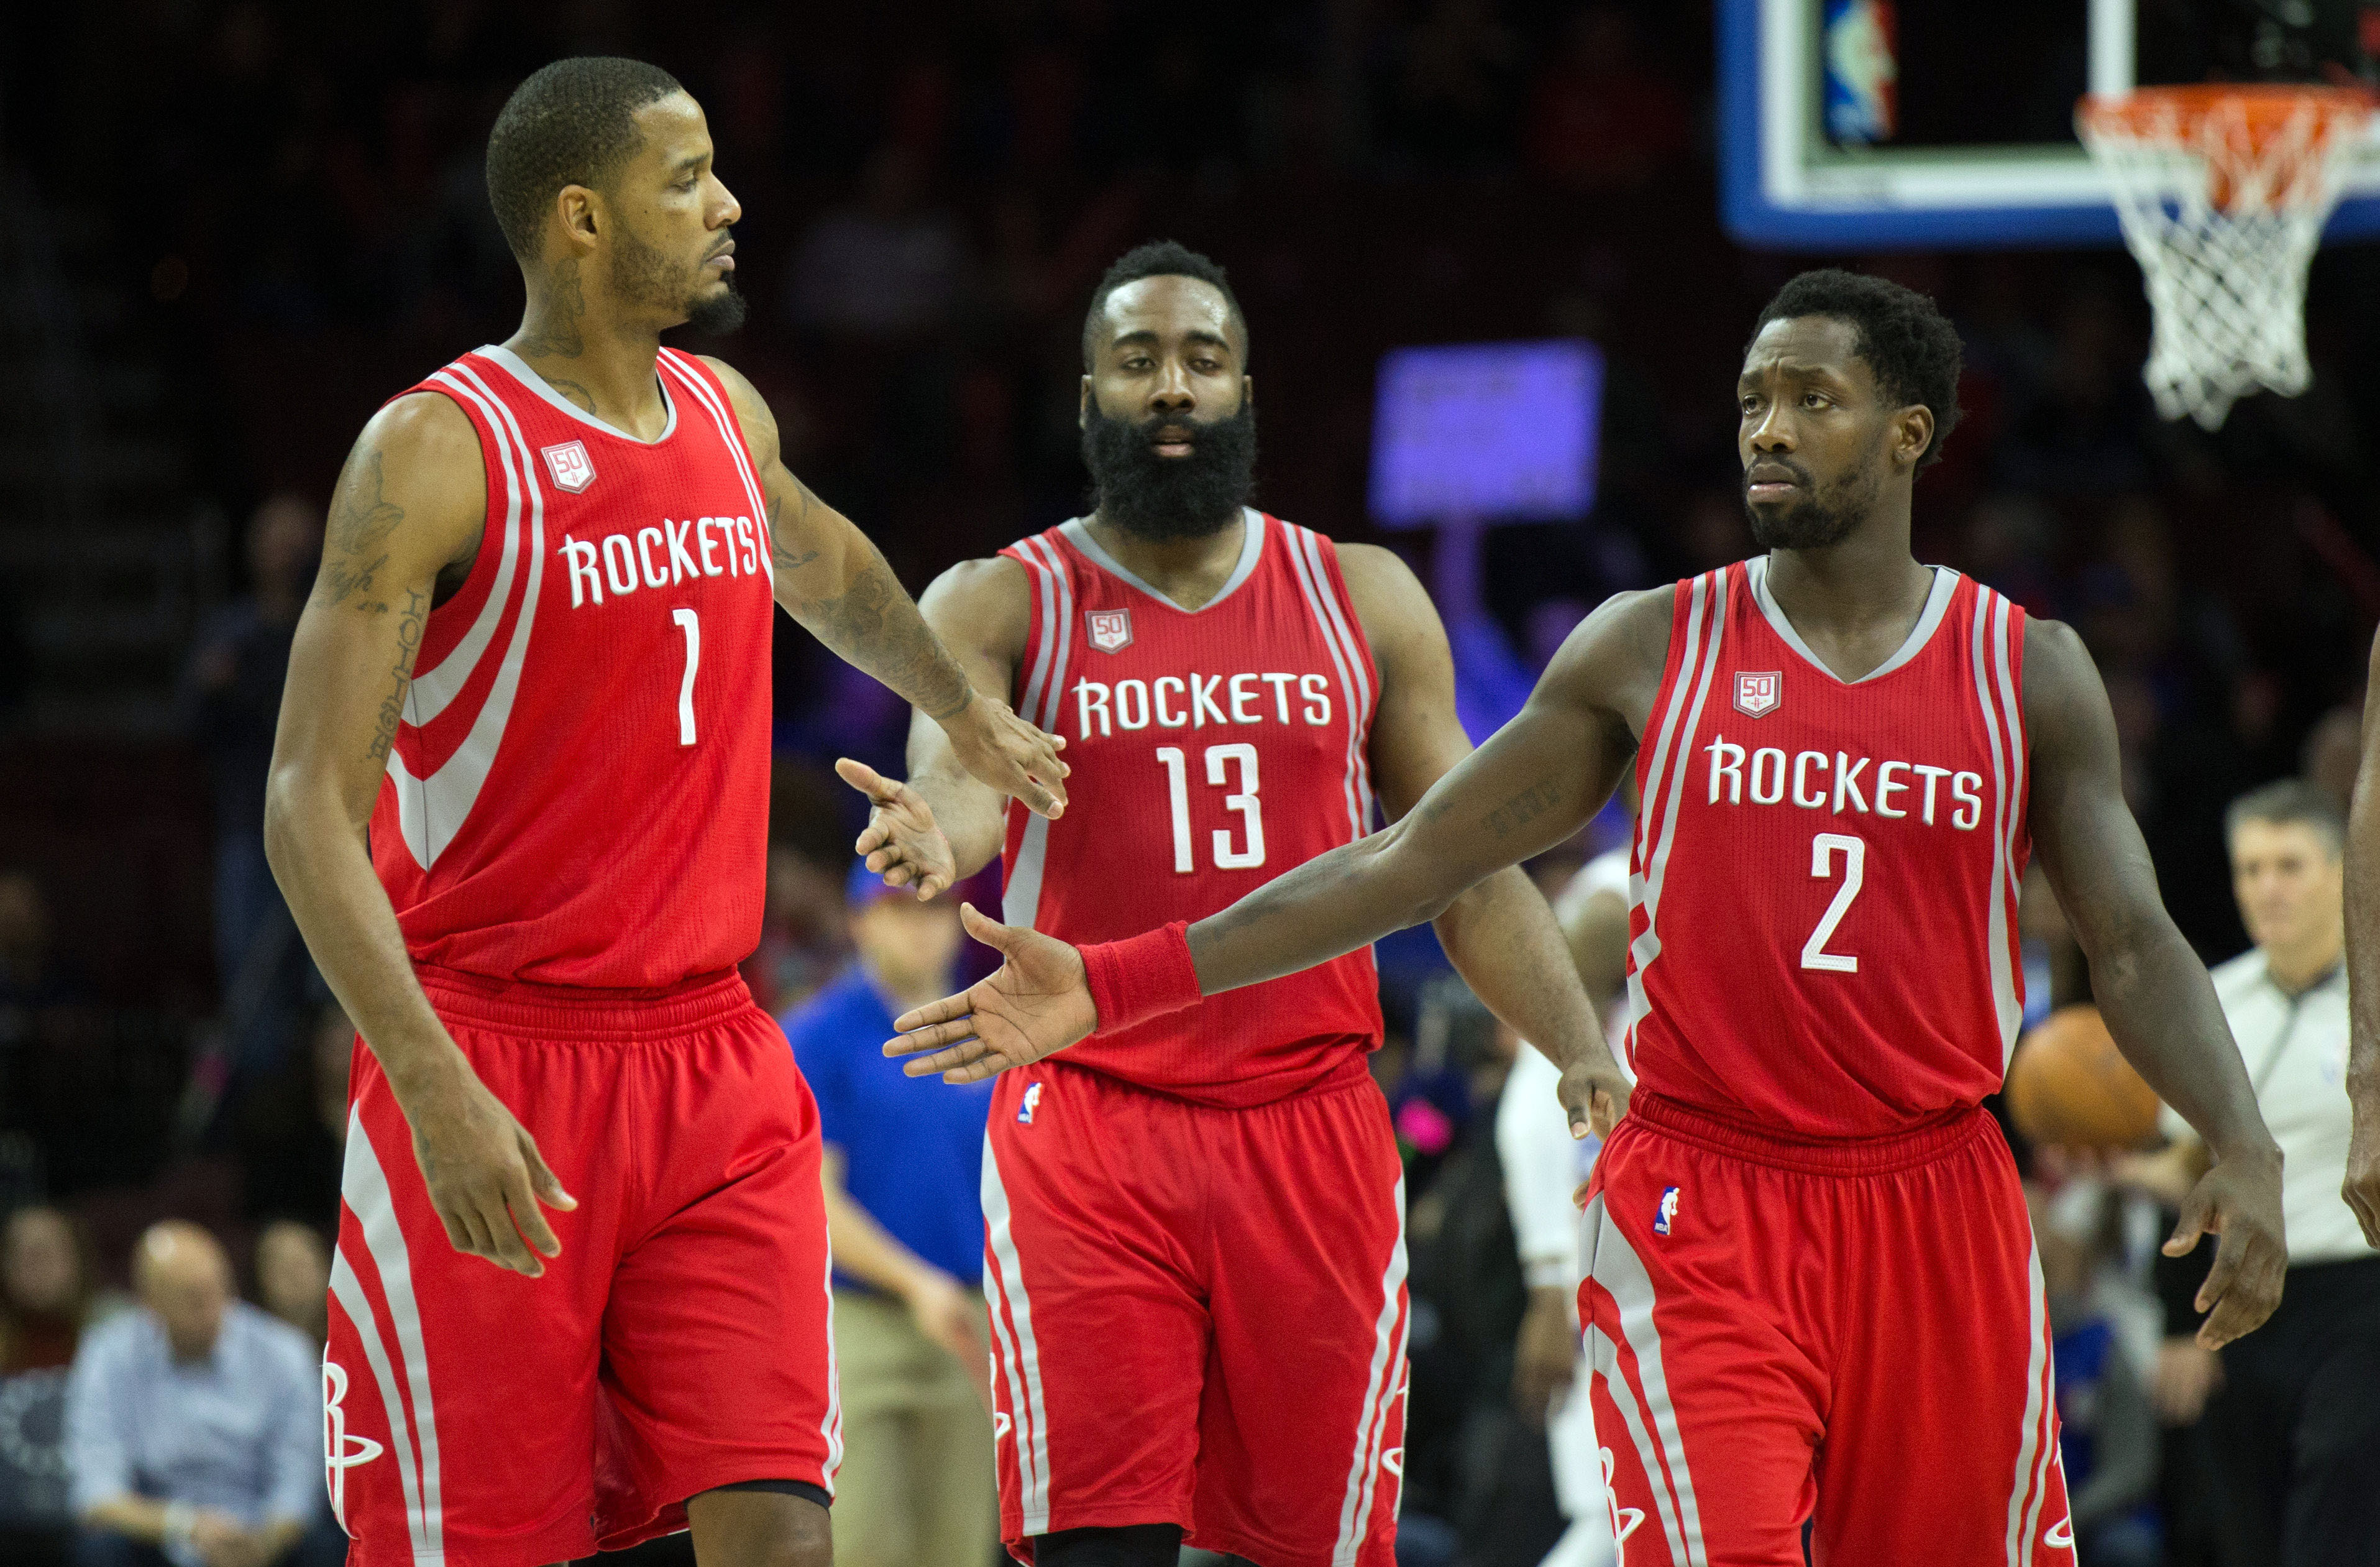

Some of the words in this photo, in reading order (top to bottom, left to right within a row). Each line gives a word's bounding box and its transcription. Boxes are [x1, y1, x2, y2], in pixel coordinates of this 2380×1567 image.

[552, 448, 582, 473] 50
[557, 516, 757, 610] ROCKETS
[1096, 614, 1122, 635] 50
[672, 608, 700, 745] 1
[1071, 672, 1331, 742] ROCKETS
[1743, 678, 1771, 696] 50
[1156, 743, 1266, 873] 13
[1703, 733, 1983, 831] ROCKETS
[1801, 832, 1865, 973] 2
